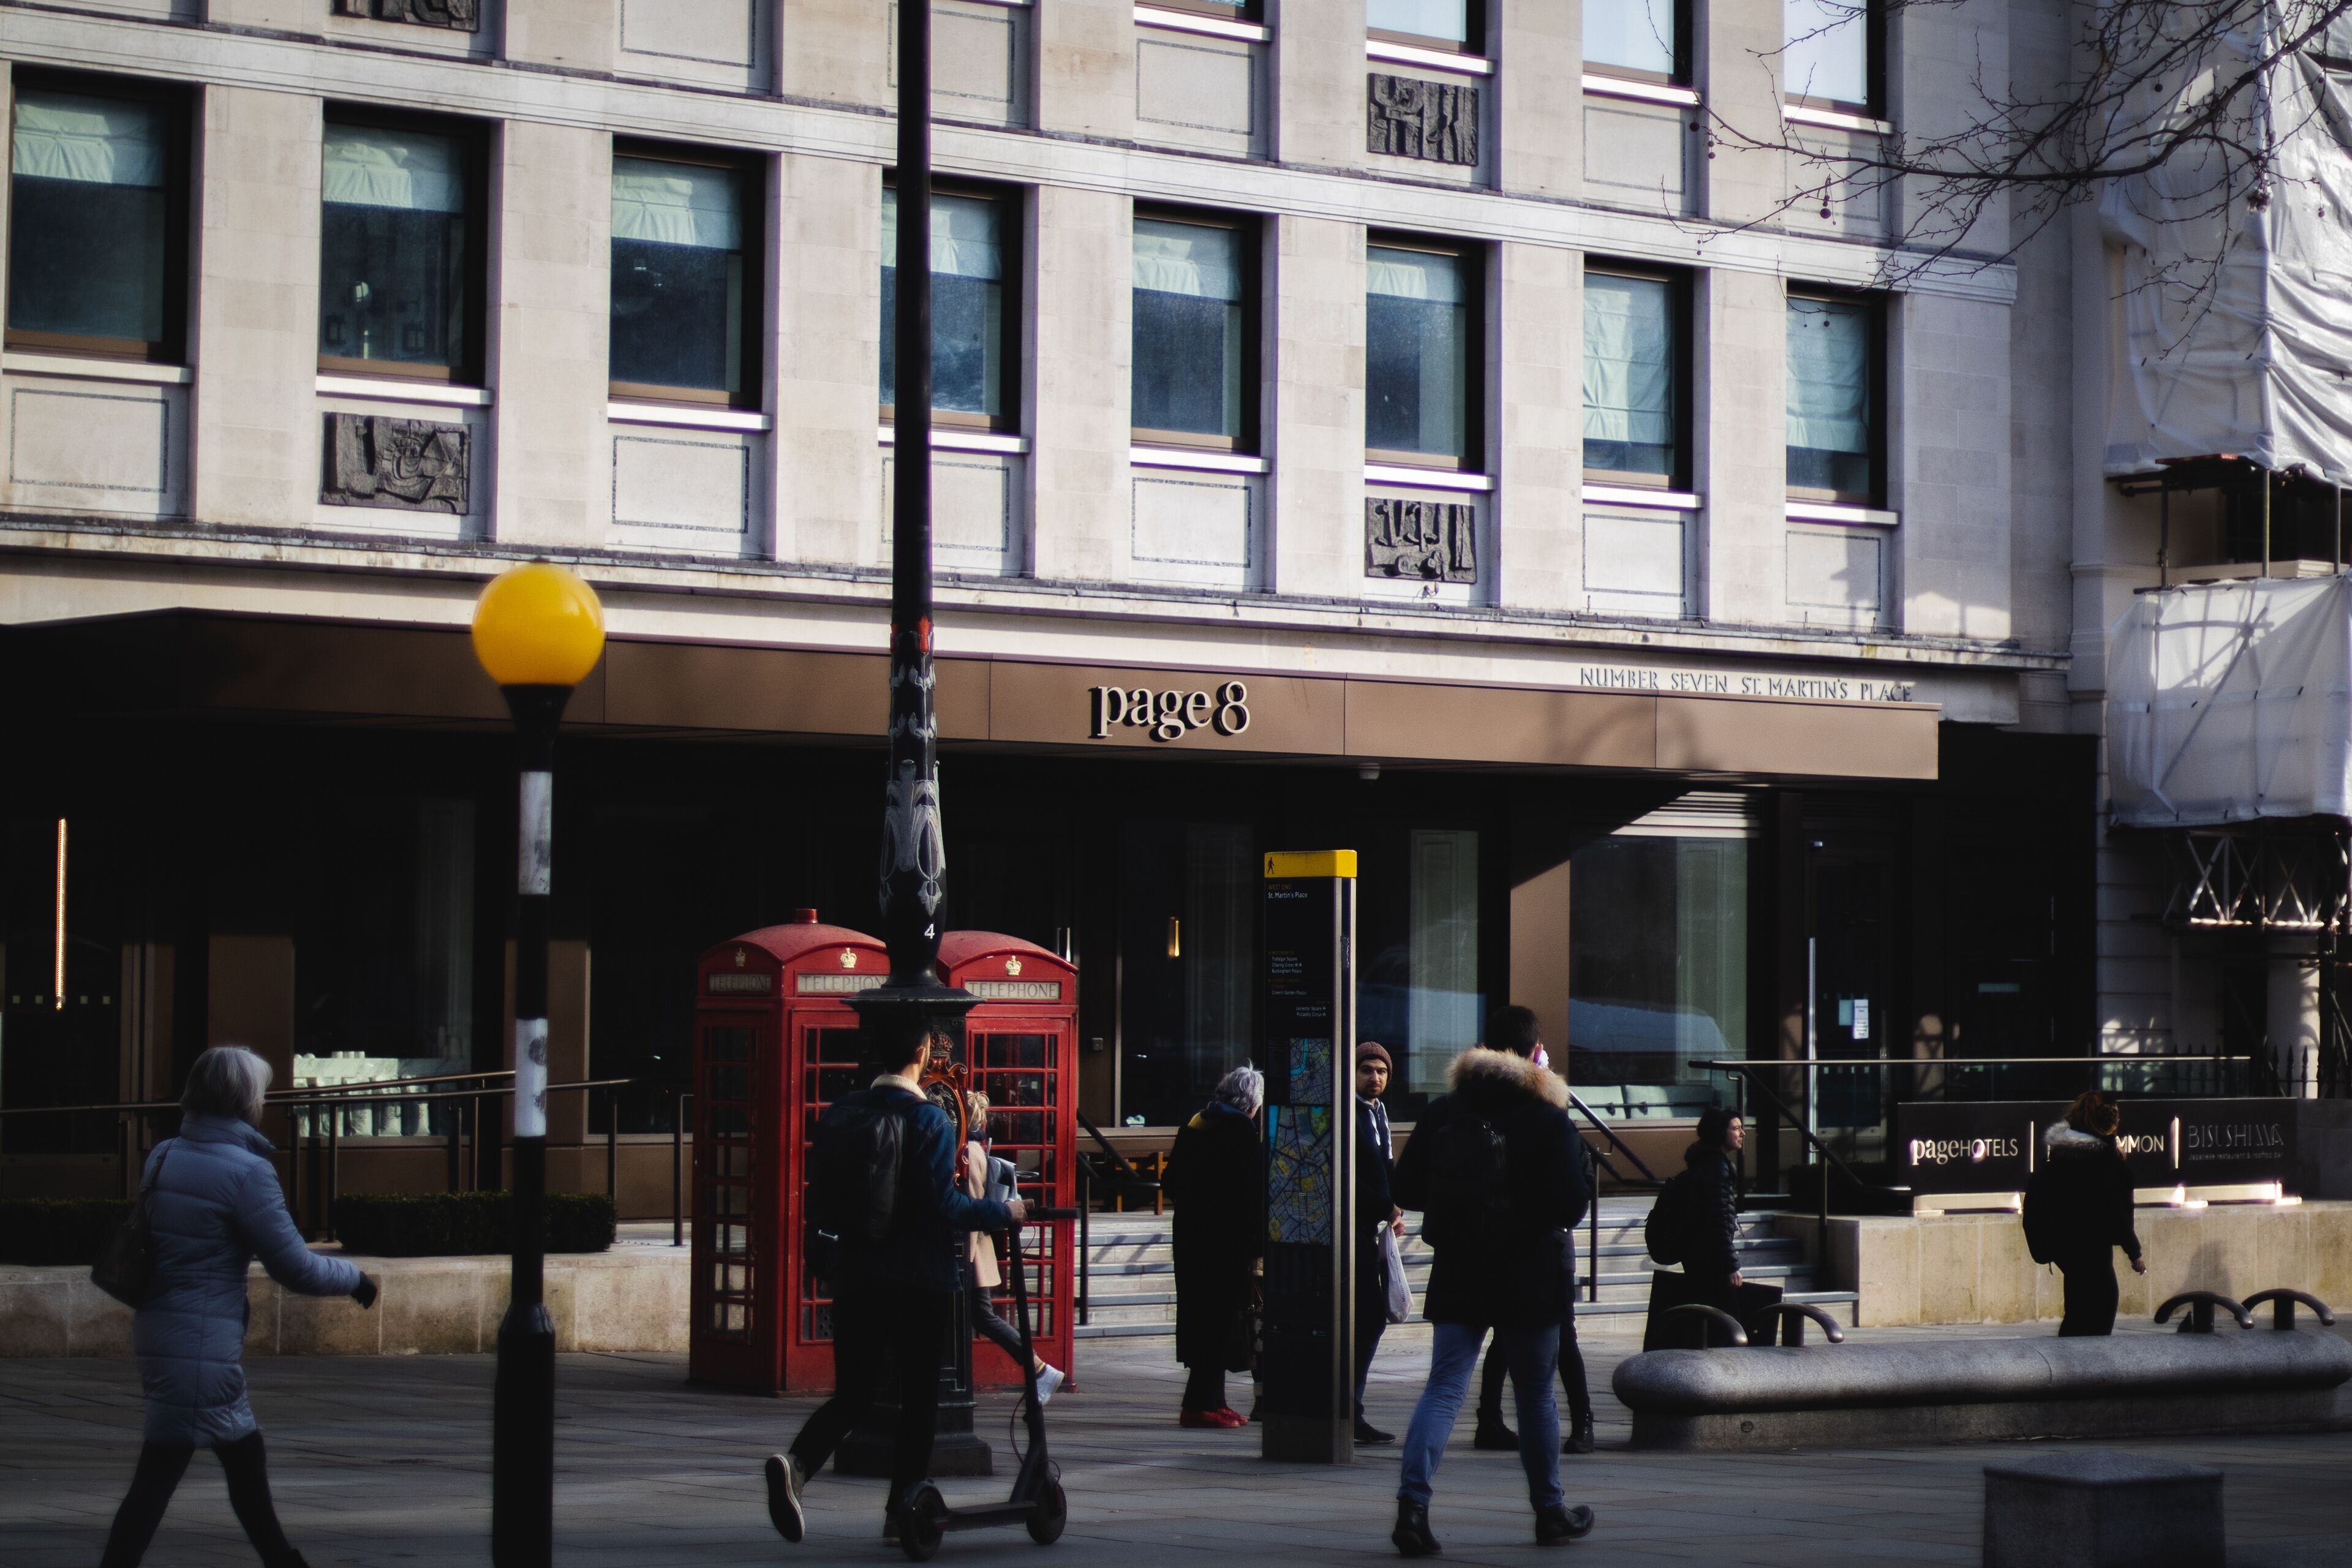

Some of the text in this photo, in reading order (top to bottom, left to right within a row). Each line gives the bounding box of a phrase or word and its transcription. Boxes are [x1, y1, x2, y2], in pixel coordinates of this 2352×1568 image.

[1580, 667, 1913, 702] NUMBER SEVEN ST. MARTIN'S PLACE
[924, 923, 935, 940] 4
[709, 974, 771, 990] TELEPHONE
[801, 976, 888, 990] TELEPHON
[968, 982, 1057, 998] TELEPHONE
[2188, 1152, 2215, 1161] Japanese
